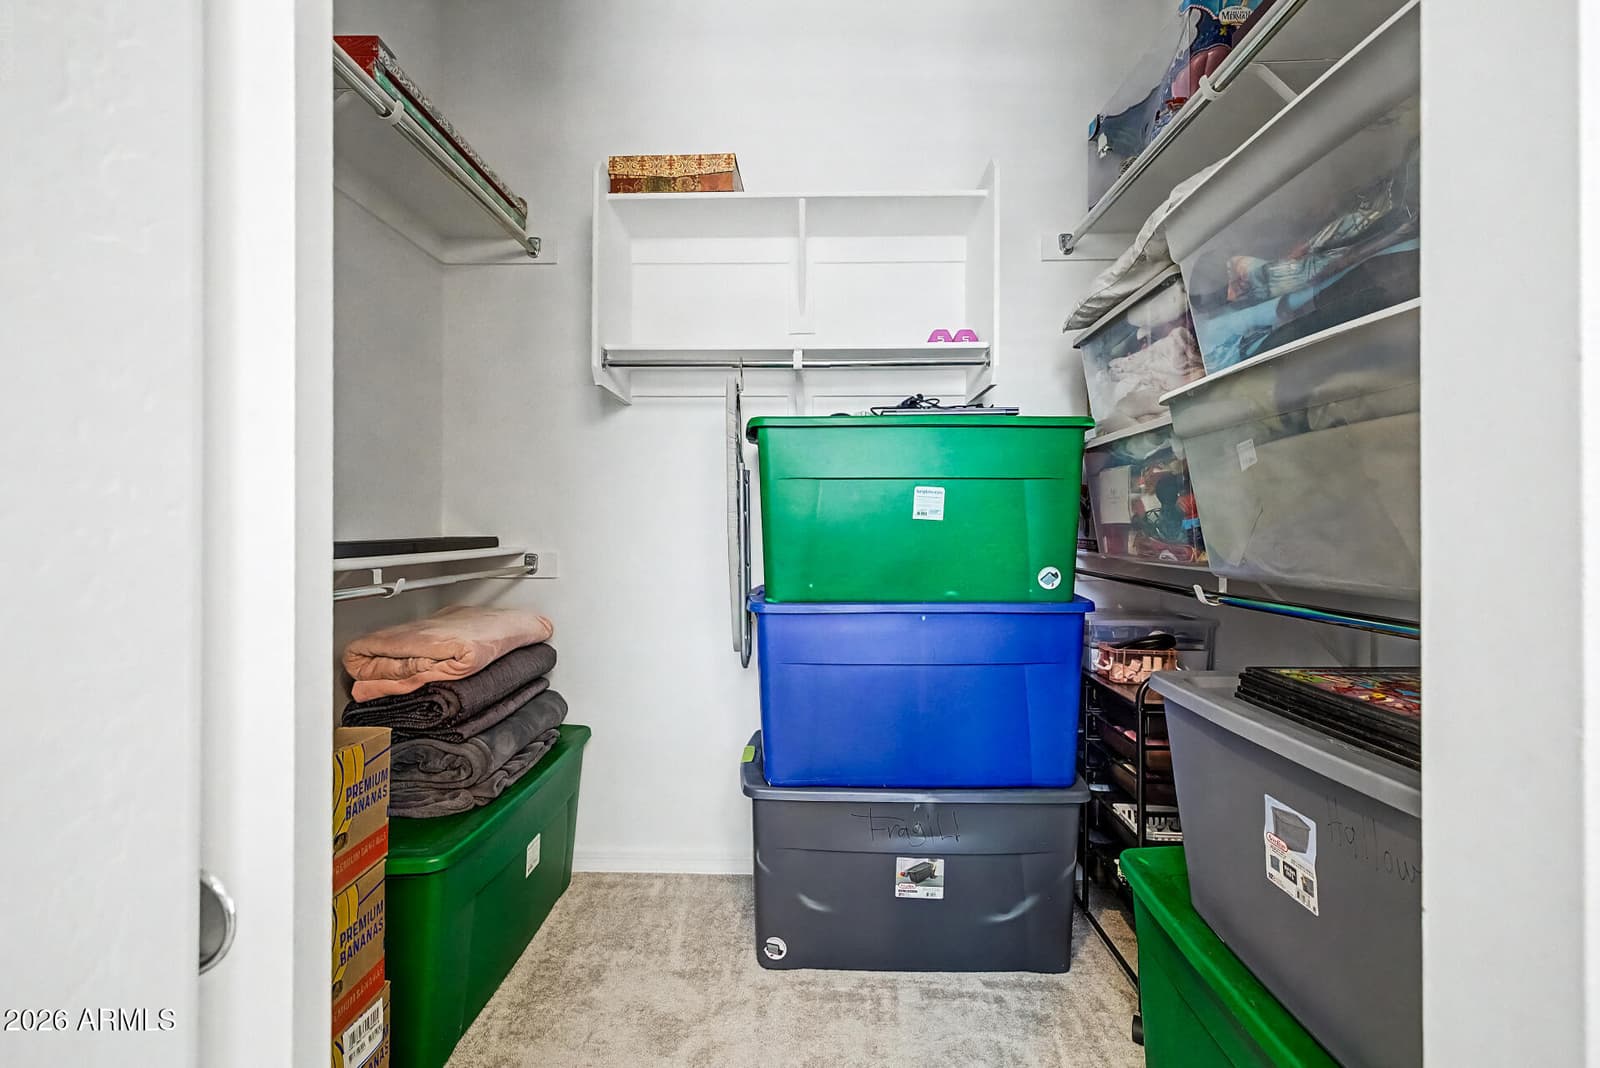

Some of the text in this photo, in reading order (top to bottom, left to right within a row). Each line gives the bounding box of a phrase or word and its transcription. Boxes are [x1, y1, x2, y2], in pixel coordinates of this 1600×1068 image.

[345, 767, 389, 803] PREMIUM
[345, 784, 388, 822] BANANAS
[339, 900, 384, 949] PREMIUM
[339, 918, 384, 968] BANANAS
